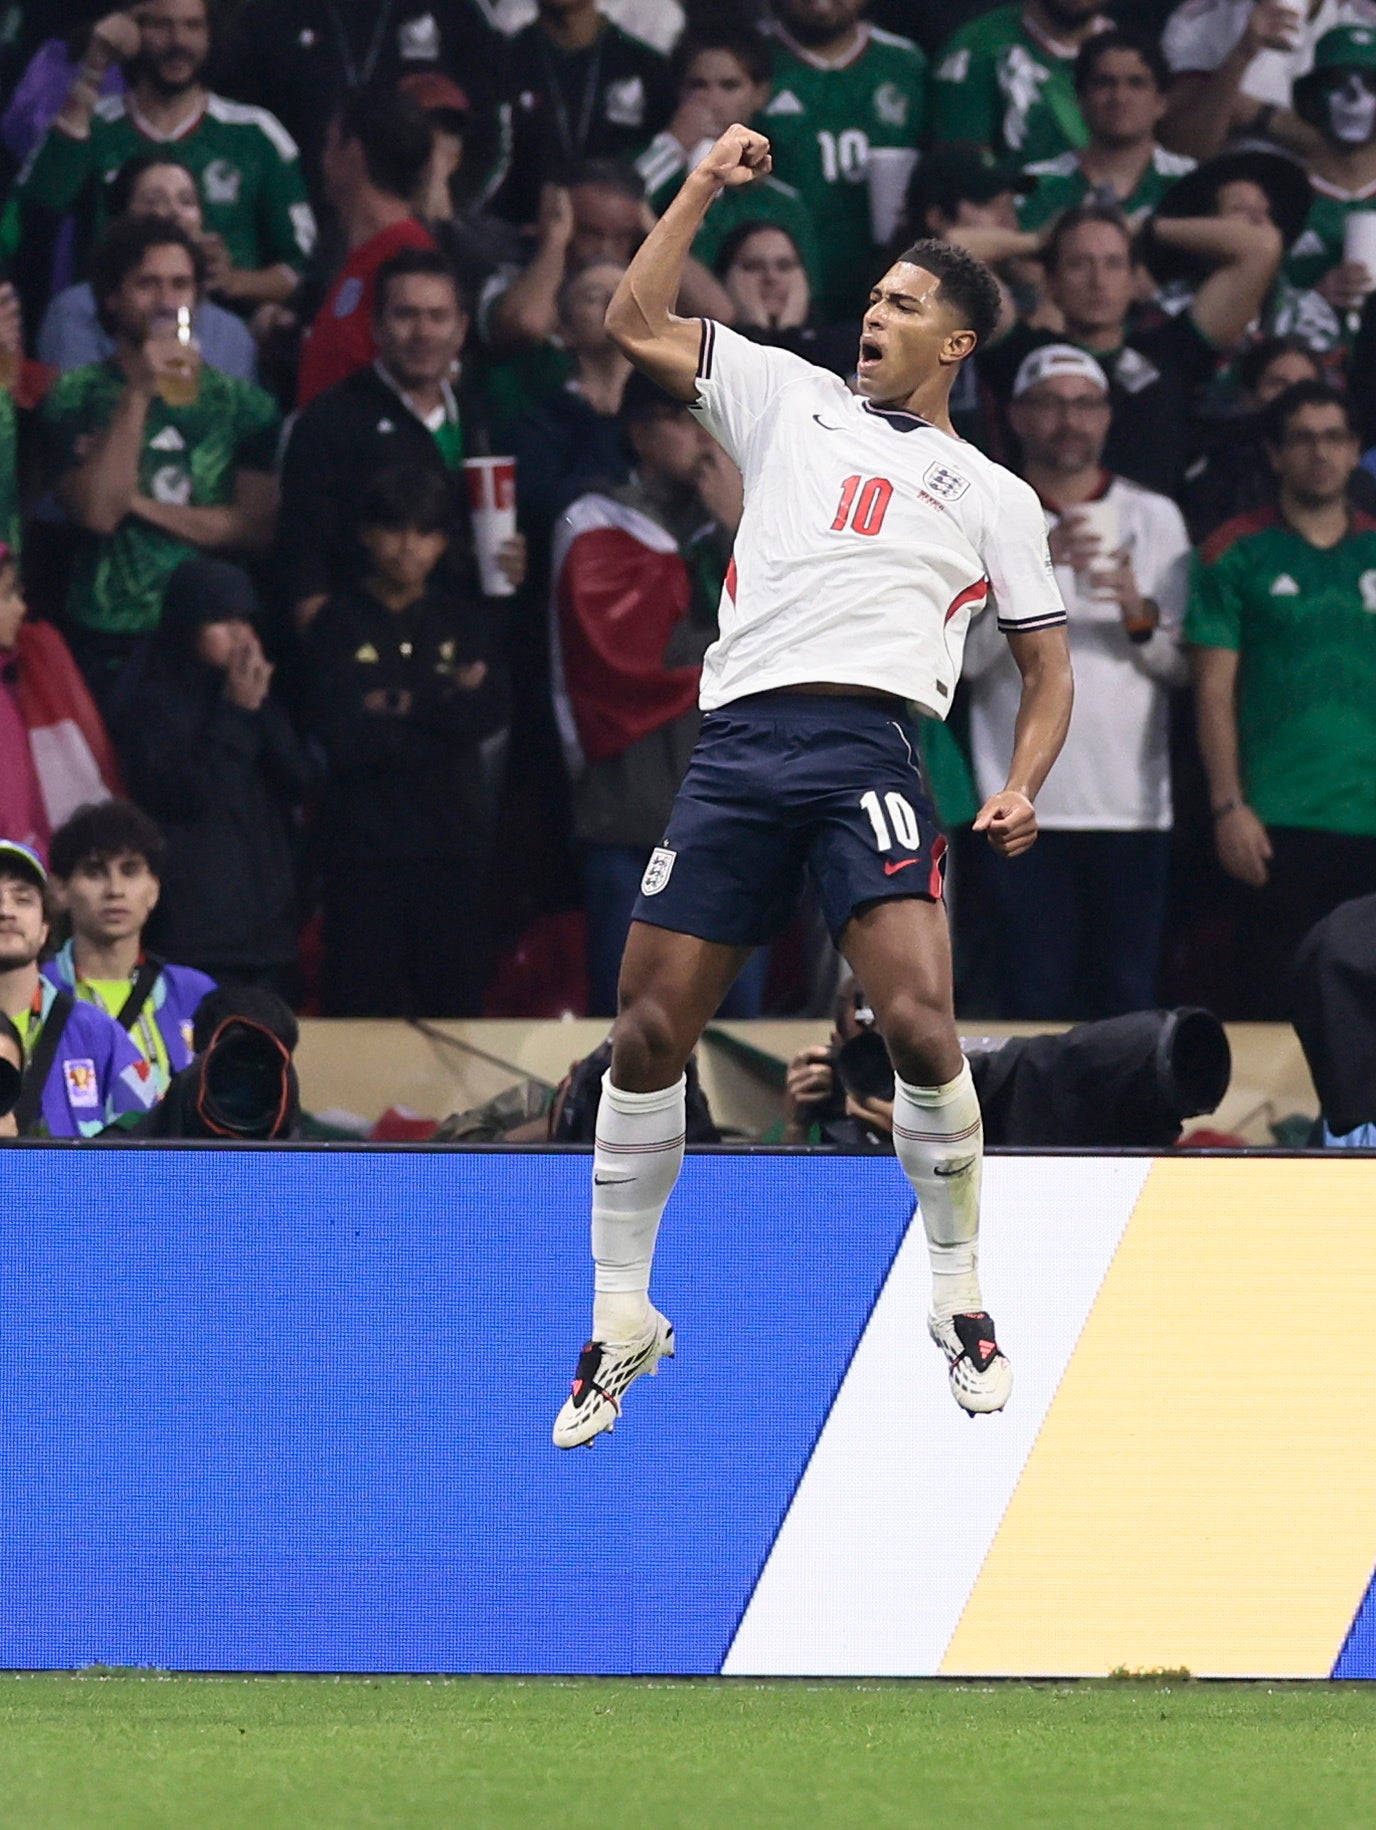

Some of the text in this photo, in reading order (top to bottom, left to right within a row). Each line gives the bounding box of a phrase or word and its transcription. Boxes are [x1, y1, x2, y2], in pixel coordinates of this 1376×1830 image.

[817, 129, 868, 181] 10
[830, 475, 894, 536] 10
[860, 791, 920, 851] 10
